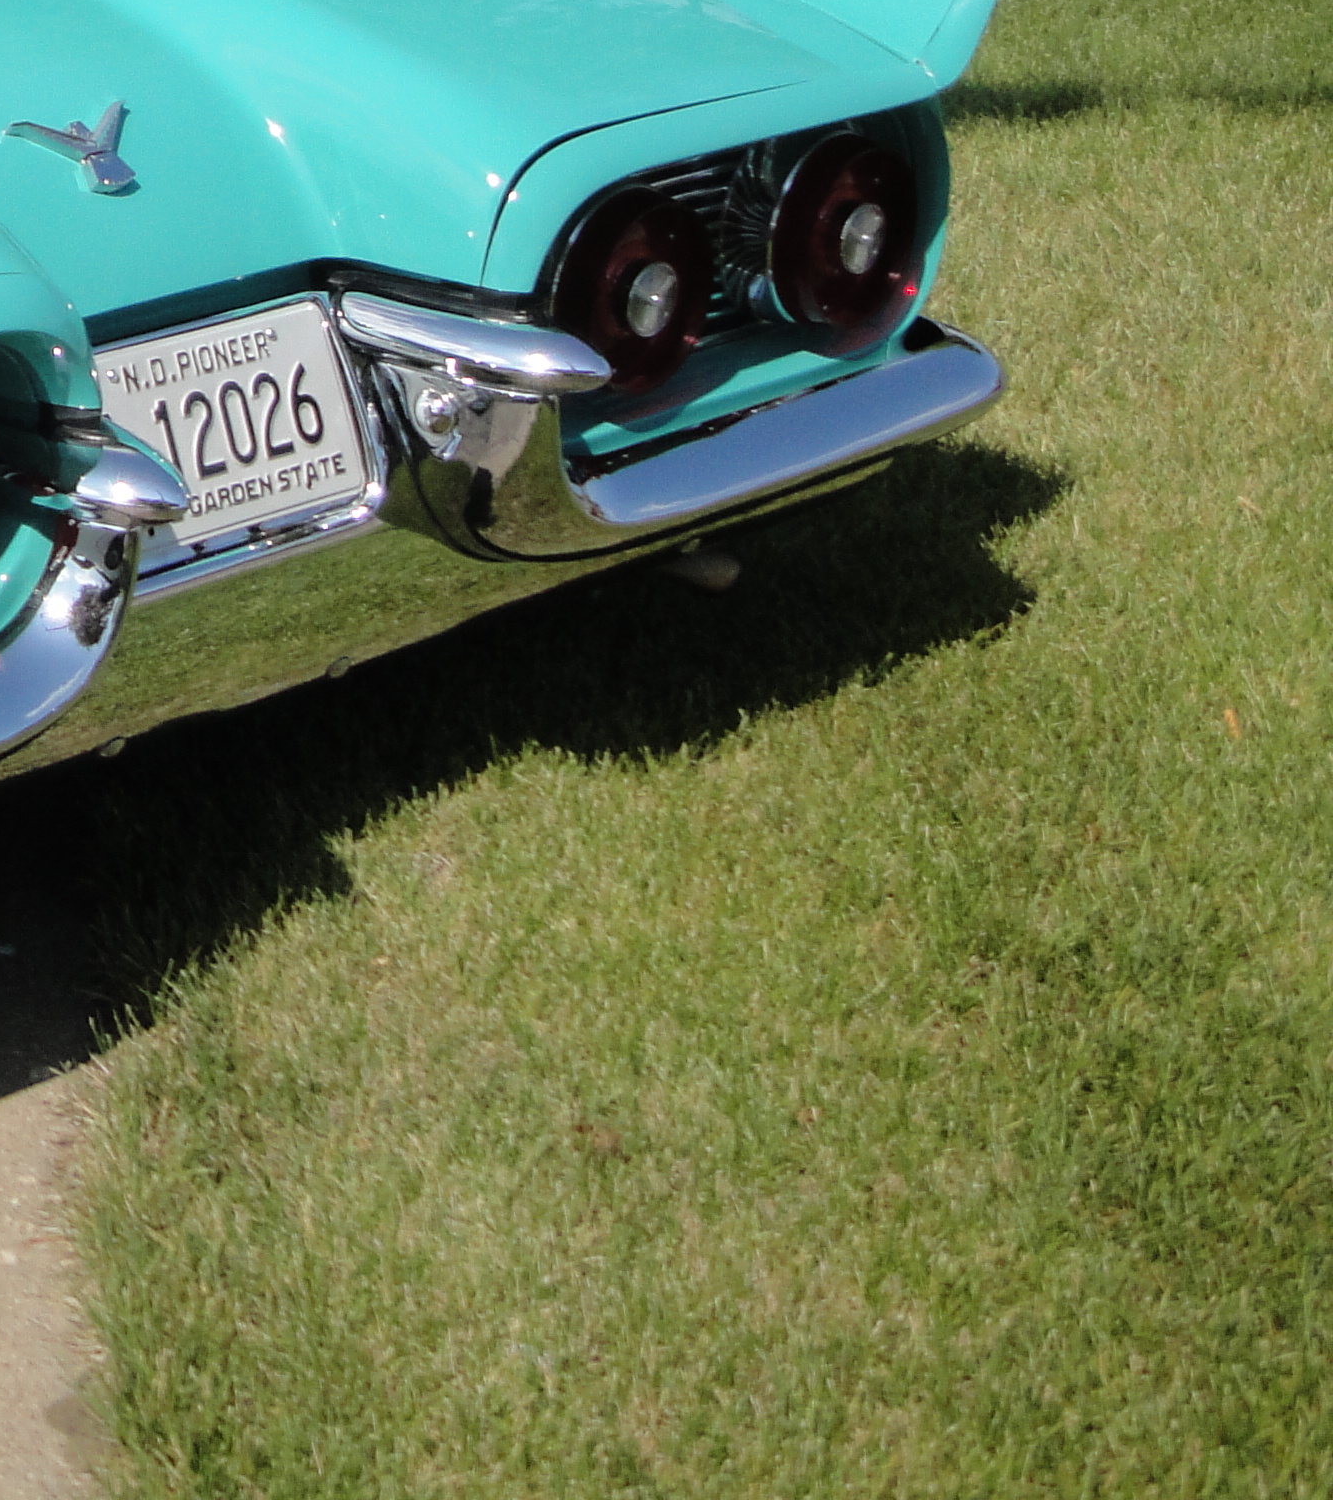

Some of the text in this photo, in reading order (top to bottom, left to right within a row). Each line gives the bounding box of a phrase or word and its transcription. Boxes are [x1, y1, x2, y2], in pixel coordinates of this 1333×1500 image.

[152, 362, 324, 481] 12026
[189, 453, 346, 517] GARDEN STATE
